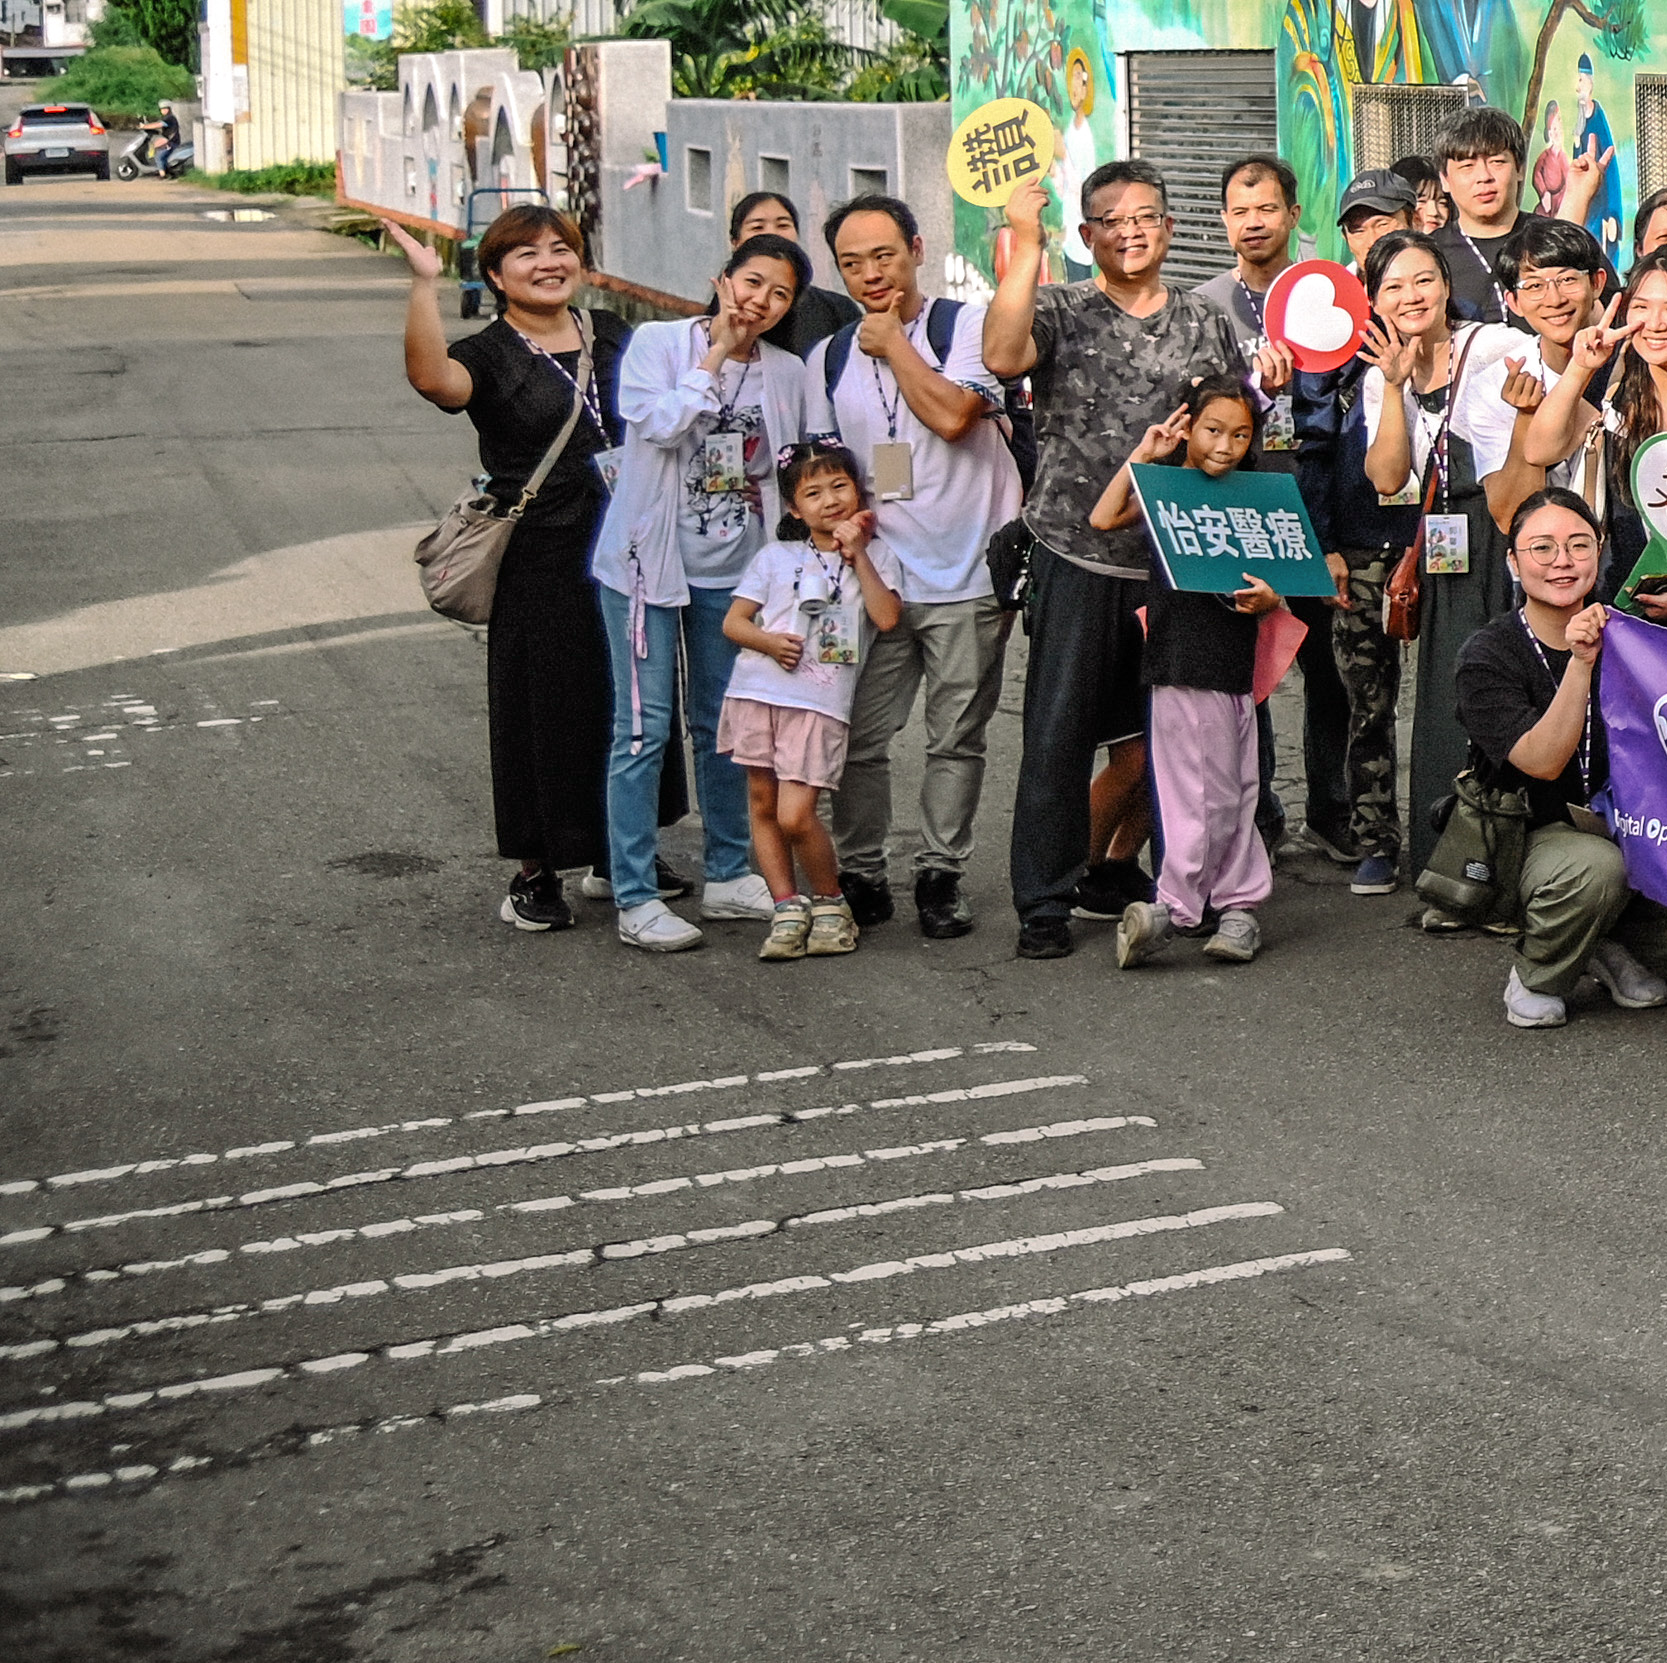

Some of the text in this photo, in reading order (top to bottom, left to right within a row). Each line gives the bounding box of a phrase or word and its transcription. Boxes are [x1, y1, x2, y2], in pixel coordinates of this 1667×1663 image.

[962, 108, 1040, 194] 讚
[1156, 500, 1312, 561] 怡安醫療
